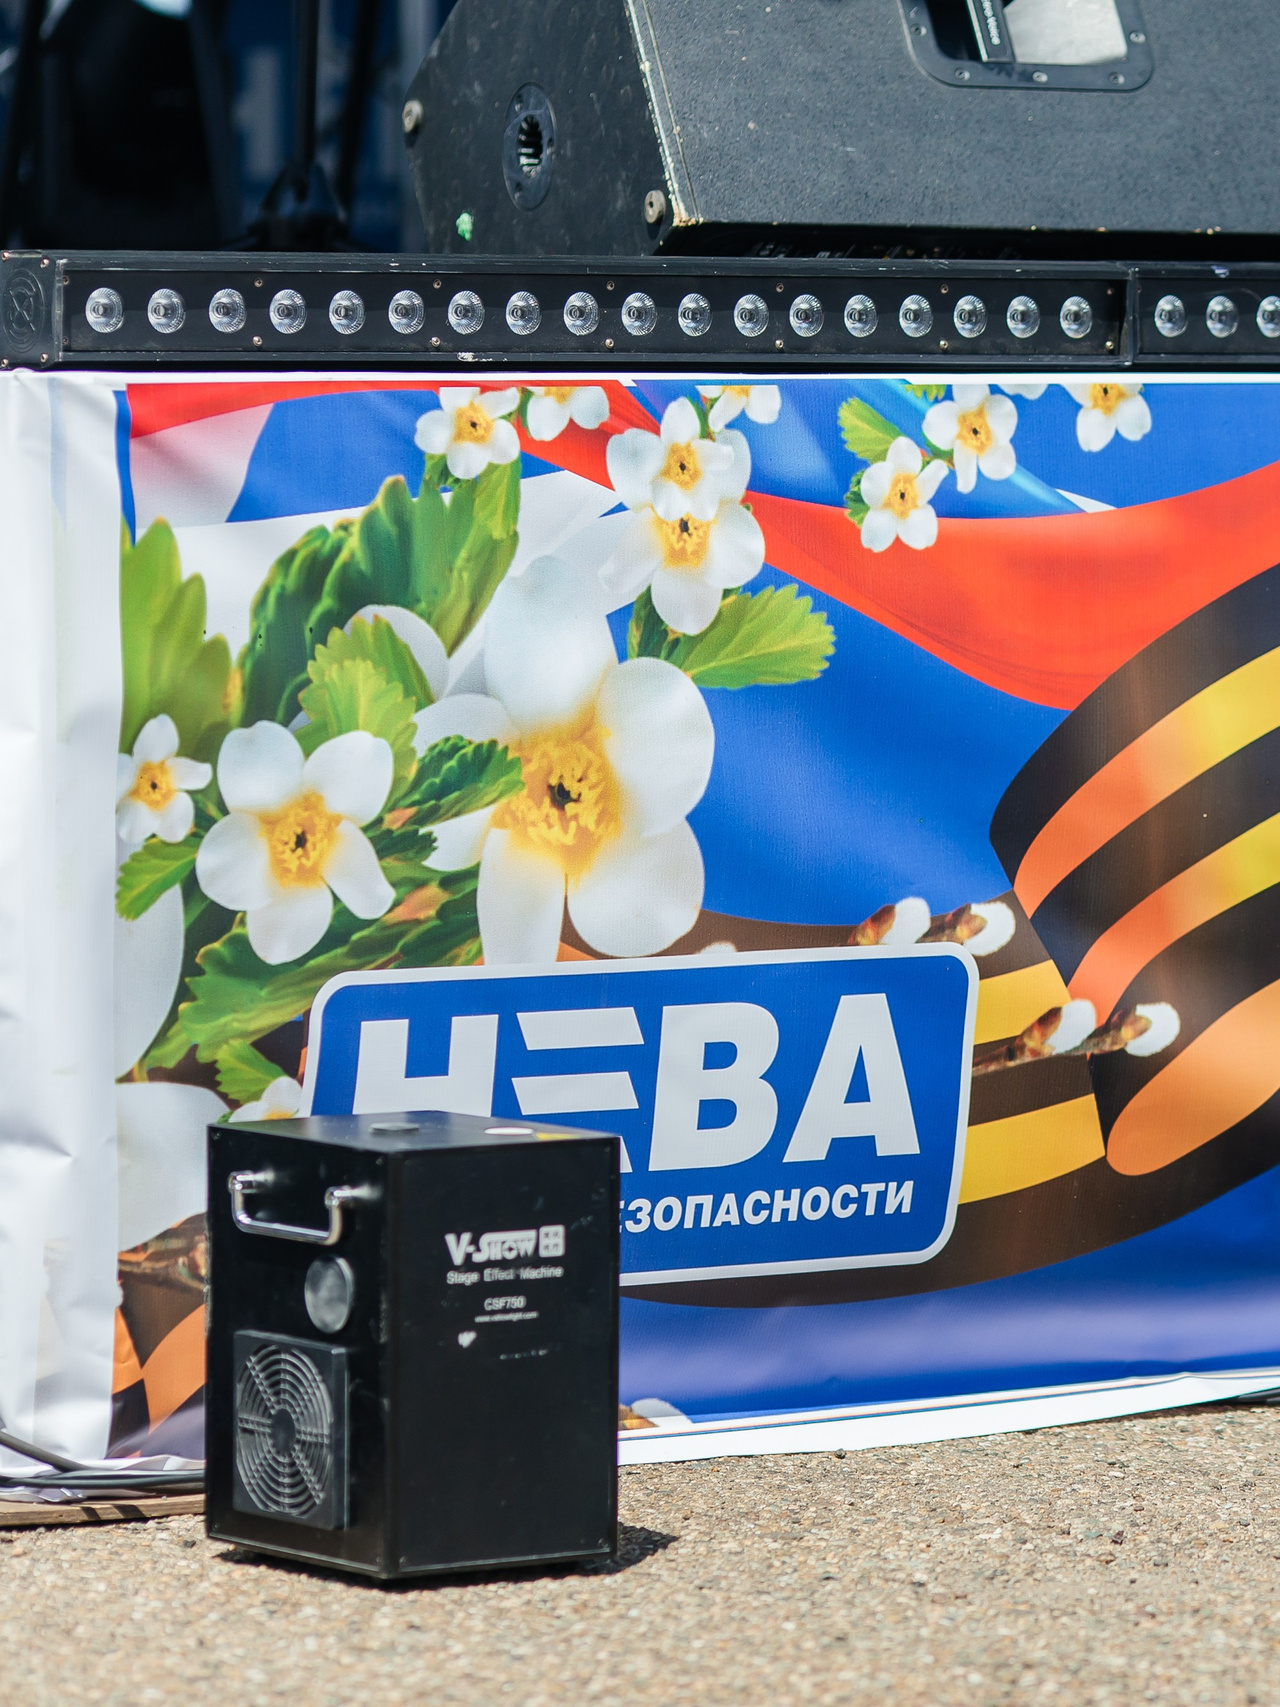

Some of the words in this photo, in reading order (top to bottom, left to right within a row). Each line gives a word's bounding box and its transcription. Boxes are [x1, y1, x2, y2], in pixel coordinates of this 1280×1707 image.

[353, 992, 921, 1174] НЕВА
[619, 1180, 915, 1234] ЗОПАСНОСТИ
[446, 1270, 481, 1286] Stage
[483, 1267, 516, 1282] Effect
[519, 1265, 565, 1280] Machine
[483, 1295, 527, 1310] CSF750
